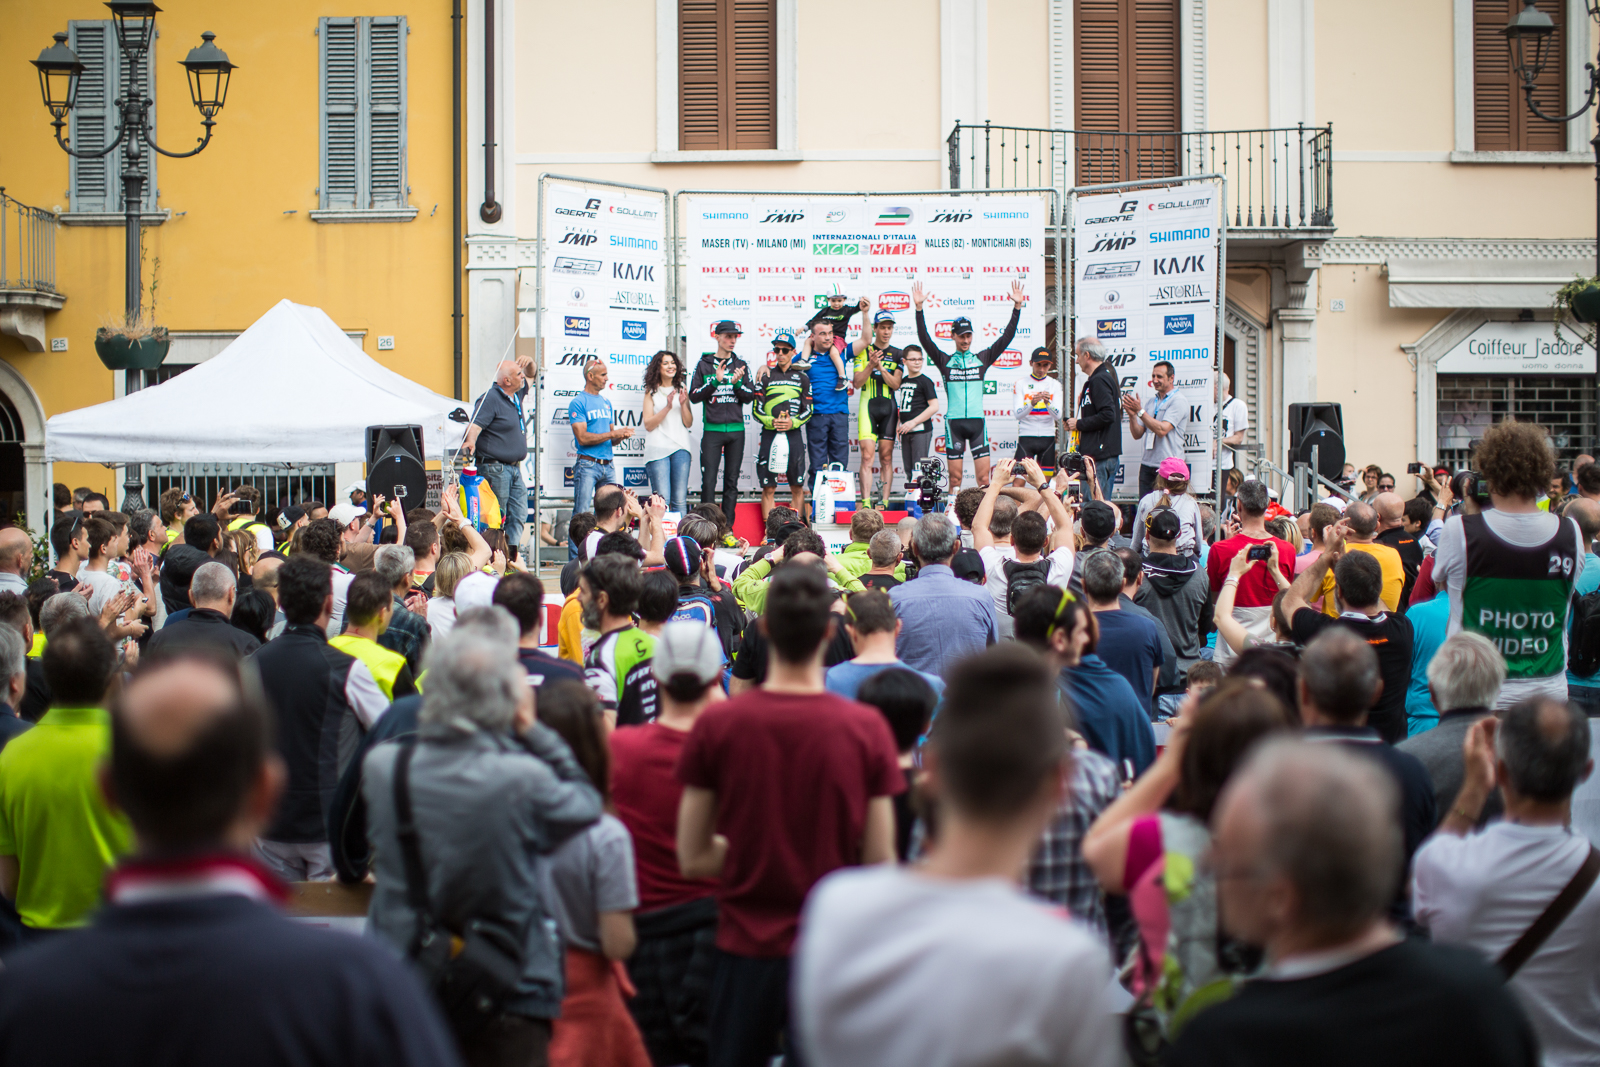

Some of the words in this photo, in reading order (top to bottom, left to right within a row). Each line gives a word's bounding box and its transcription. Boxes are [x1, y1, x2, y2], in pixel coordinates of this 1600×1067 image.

[1157, 197, 1211, 210] SOULLIMIT
[616, 206, 658, 219] SOULLIMIT
[702, 212, 749, 220] SHIMANO
[759, 213, 805, 223] SMP
[927, 213, 973, 223] SMP
[558, 232, 598, 247] SMP
[1149, 227, 1210, 243] SHIMANO
[609, 235, 658, 251] SHIMANO
[702, 239, 730, 248] MASER
[732, 238, 749, 250] (TV)
[756, 239, 788, 248] MILANO
[789, 238, 806, 250] (MI)
[813, 244, 858, 255] XCO
[870, 244, 916, 255] MTB
[924, 238, 950, 248] NALLES
[951, 238, 965, 249] (BZ)
[971, 238, 1017, 248] MONTICHIARI
[1018, 238, 1032, 249] (BS)
[1087, 237, 1136, 253] SMP
[1153, 255, 1205, 275] KASK
[613, 262, 655, 282] KASK
[614, 290, 655, 306] ASTORIA
[1156, 284, 1203, 300] ASTORIA
[718, 297, 750, 306] citelum
[943, 297, 975, 306] citelum
[1332, 300, 1344, 310] 28
[1112, 320, 1125, 331] GLS
[1166, 320, 1192, 329] MANIVA
[53, 340, 66, 349] 25
[380, 338, 392, 347] 26
[1469, 338, 1527, 356] Coiffeur
[998, 353, 1022, 361] MICA
[1105, 353, 1136, 366] MP
[1149, 347, 1209, 361] SHIMANO
[1548, 556, 1574, 575] 29
[1479, 608, 1555, 630] PHOTO
